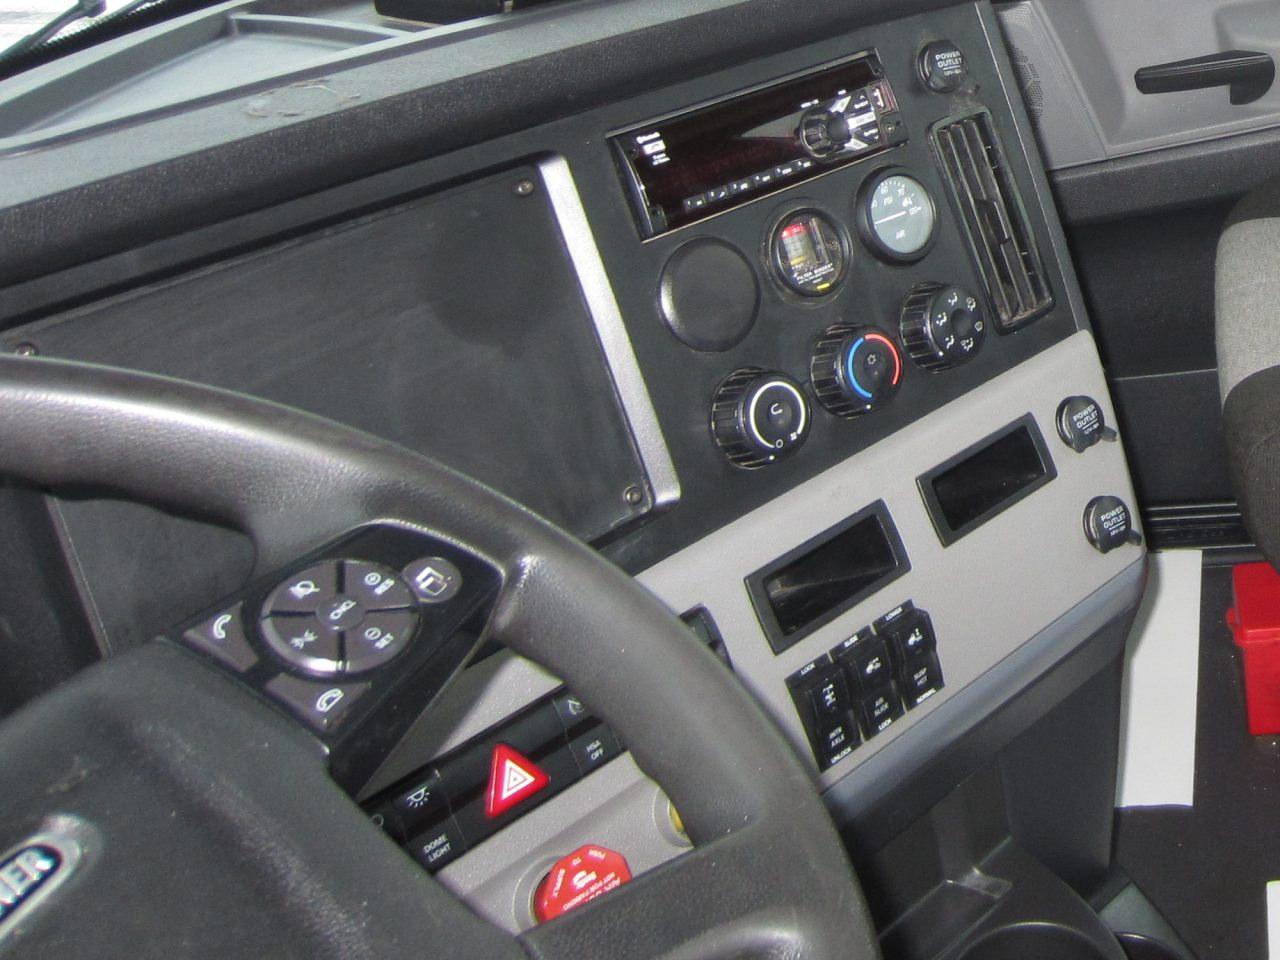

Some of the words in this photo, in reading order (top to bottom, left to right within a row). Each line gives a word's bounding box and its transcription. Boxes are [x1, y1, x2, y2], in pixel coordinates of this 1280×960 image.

[935, 50, 960, 60] POWER
[937, 58, 962, 68] OUTLET
[1073, 404, 1095, 421] POWER
[1076, 410, 1098, 428] OUTLET
[1100, 505, 1124, 522] POWER
[1103, 512, 1126, 529] OUTLET
[885, 606, 903, 621] LOWER
[374, 633, 394, 649] SET
[800, 662, 816, 676] LOCK
[913, 667, 928, 680] SUSP
[873, 702, 889, 716] SLIDE
[878, 717, 892, 731] LOCK
[831, 733, 846, 748] AXLE
[591, 747, 605, 760] OFF
[830, 746, 852, 764] UNLOCK
[424, 833, 448, 854] DOME
[429, 842, 451, 862] LIGHT
[588, 849, 606, 860] PUSH
